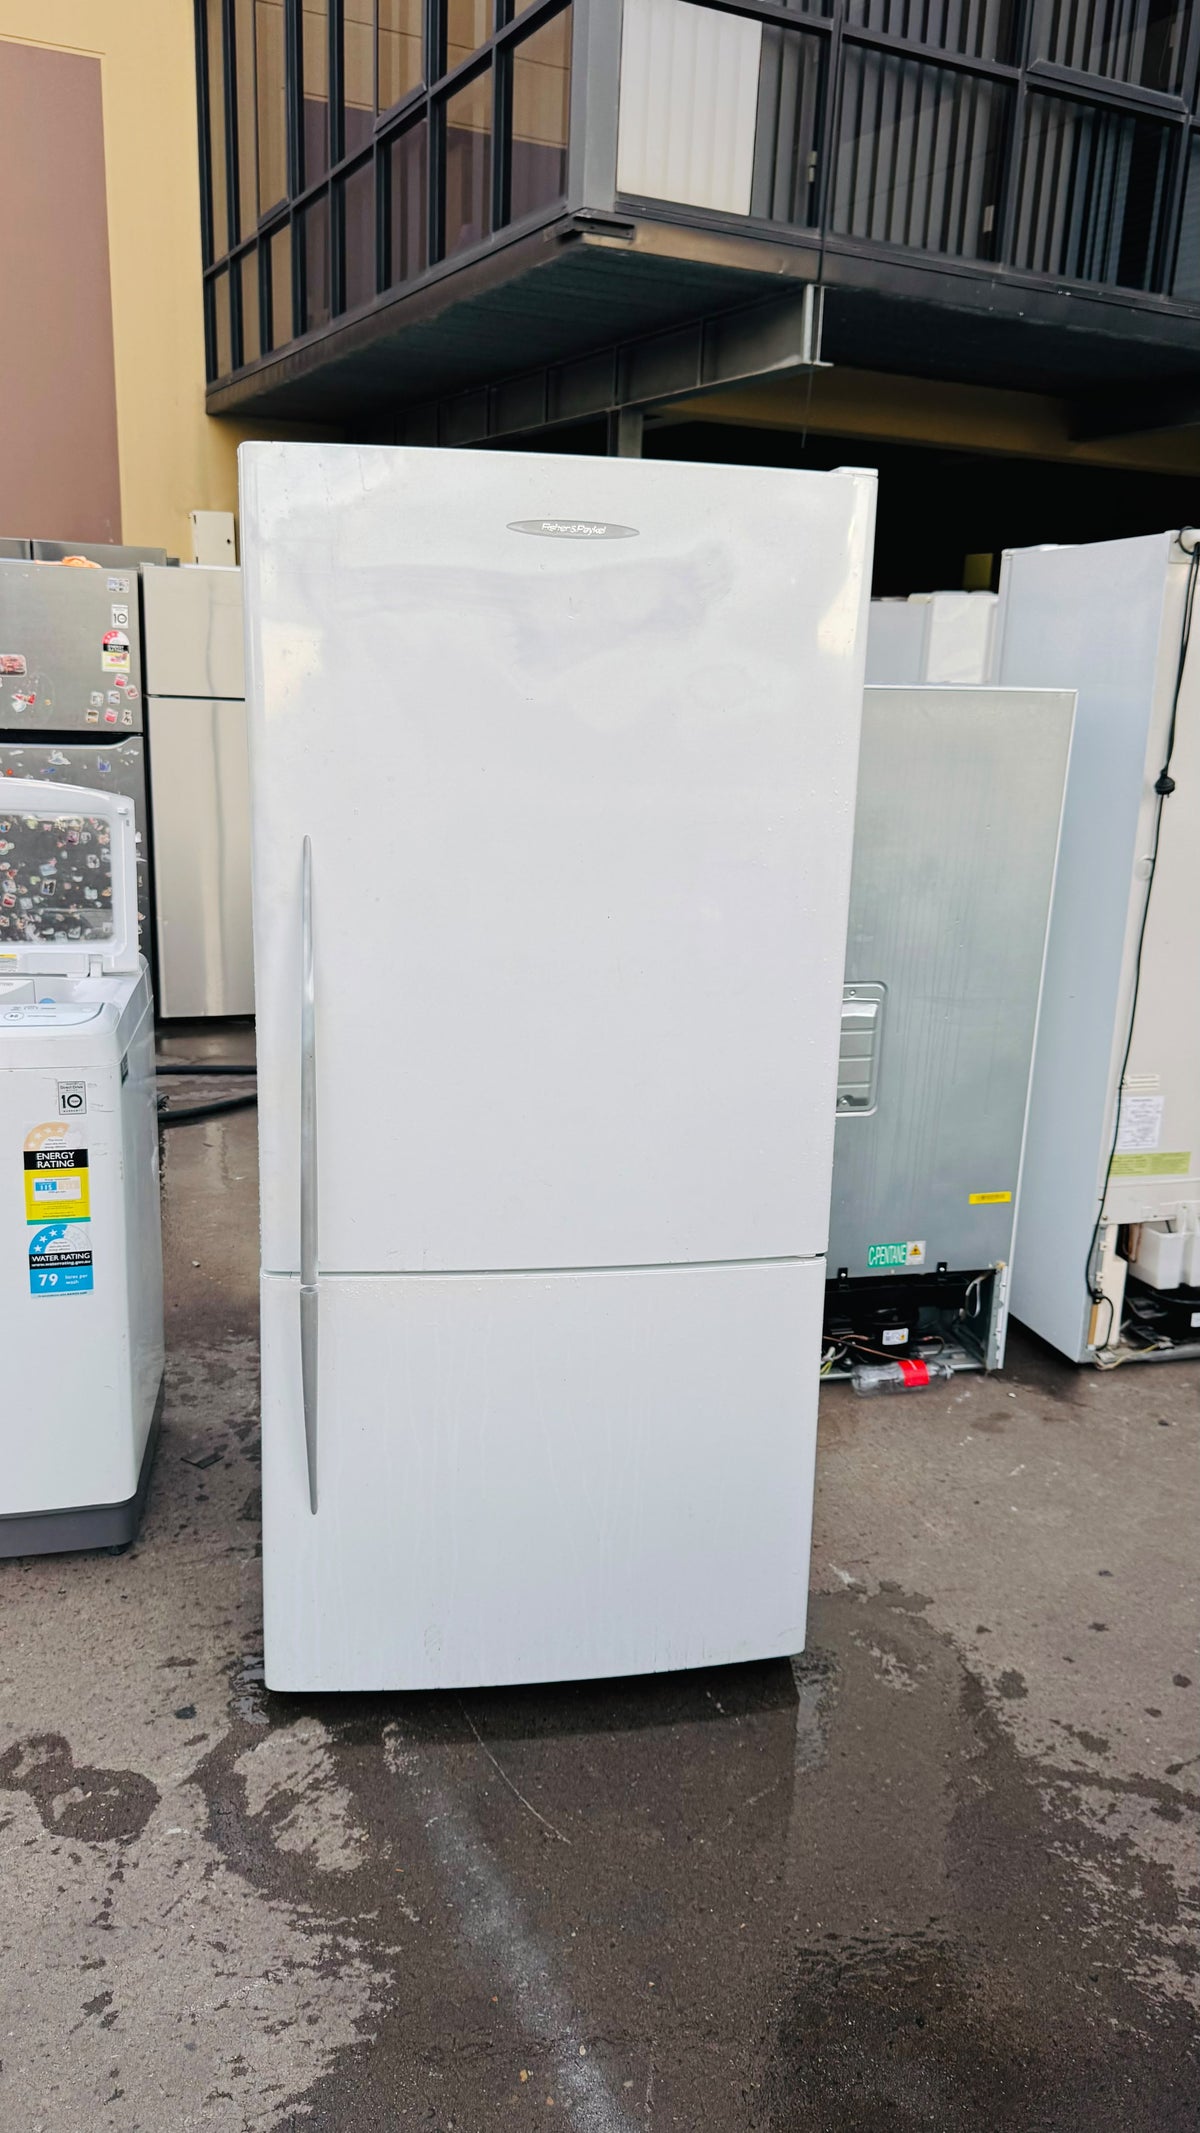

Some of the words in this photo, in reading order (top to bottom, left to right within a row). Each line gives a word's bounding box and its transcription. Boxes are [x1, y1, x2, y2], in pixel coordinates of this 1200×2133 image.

[113, 613, 127, 624] 10
[61, 1093, 83, 1109] 10
[36, 1151, 75, 1161] ENERGY
[36, 1159, 75, 1169] RATING
[31, 1254, 59, 1262] WATER
[60, 1252, 91, 1261] RATING
[869, 1244, 906, 1265] C-PENTANE
[38, 1273, 59, 1287] 79
